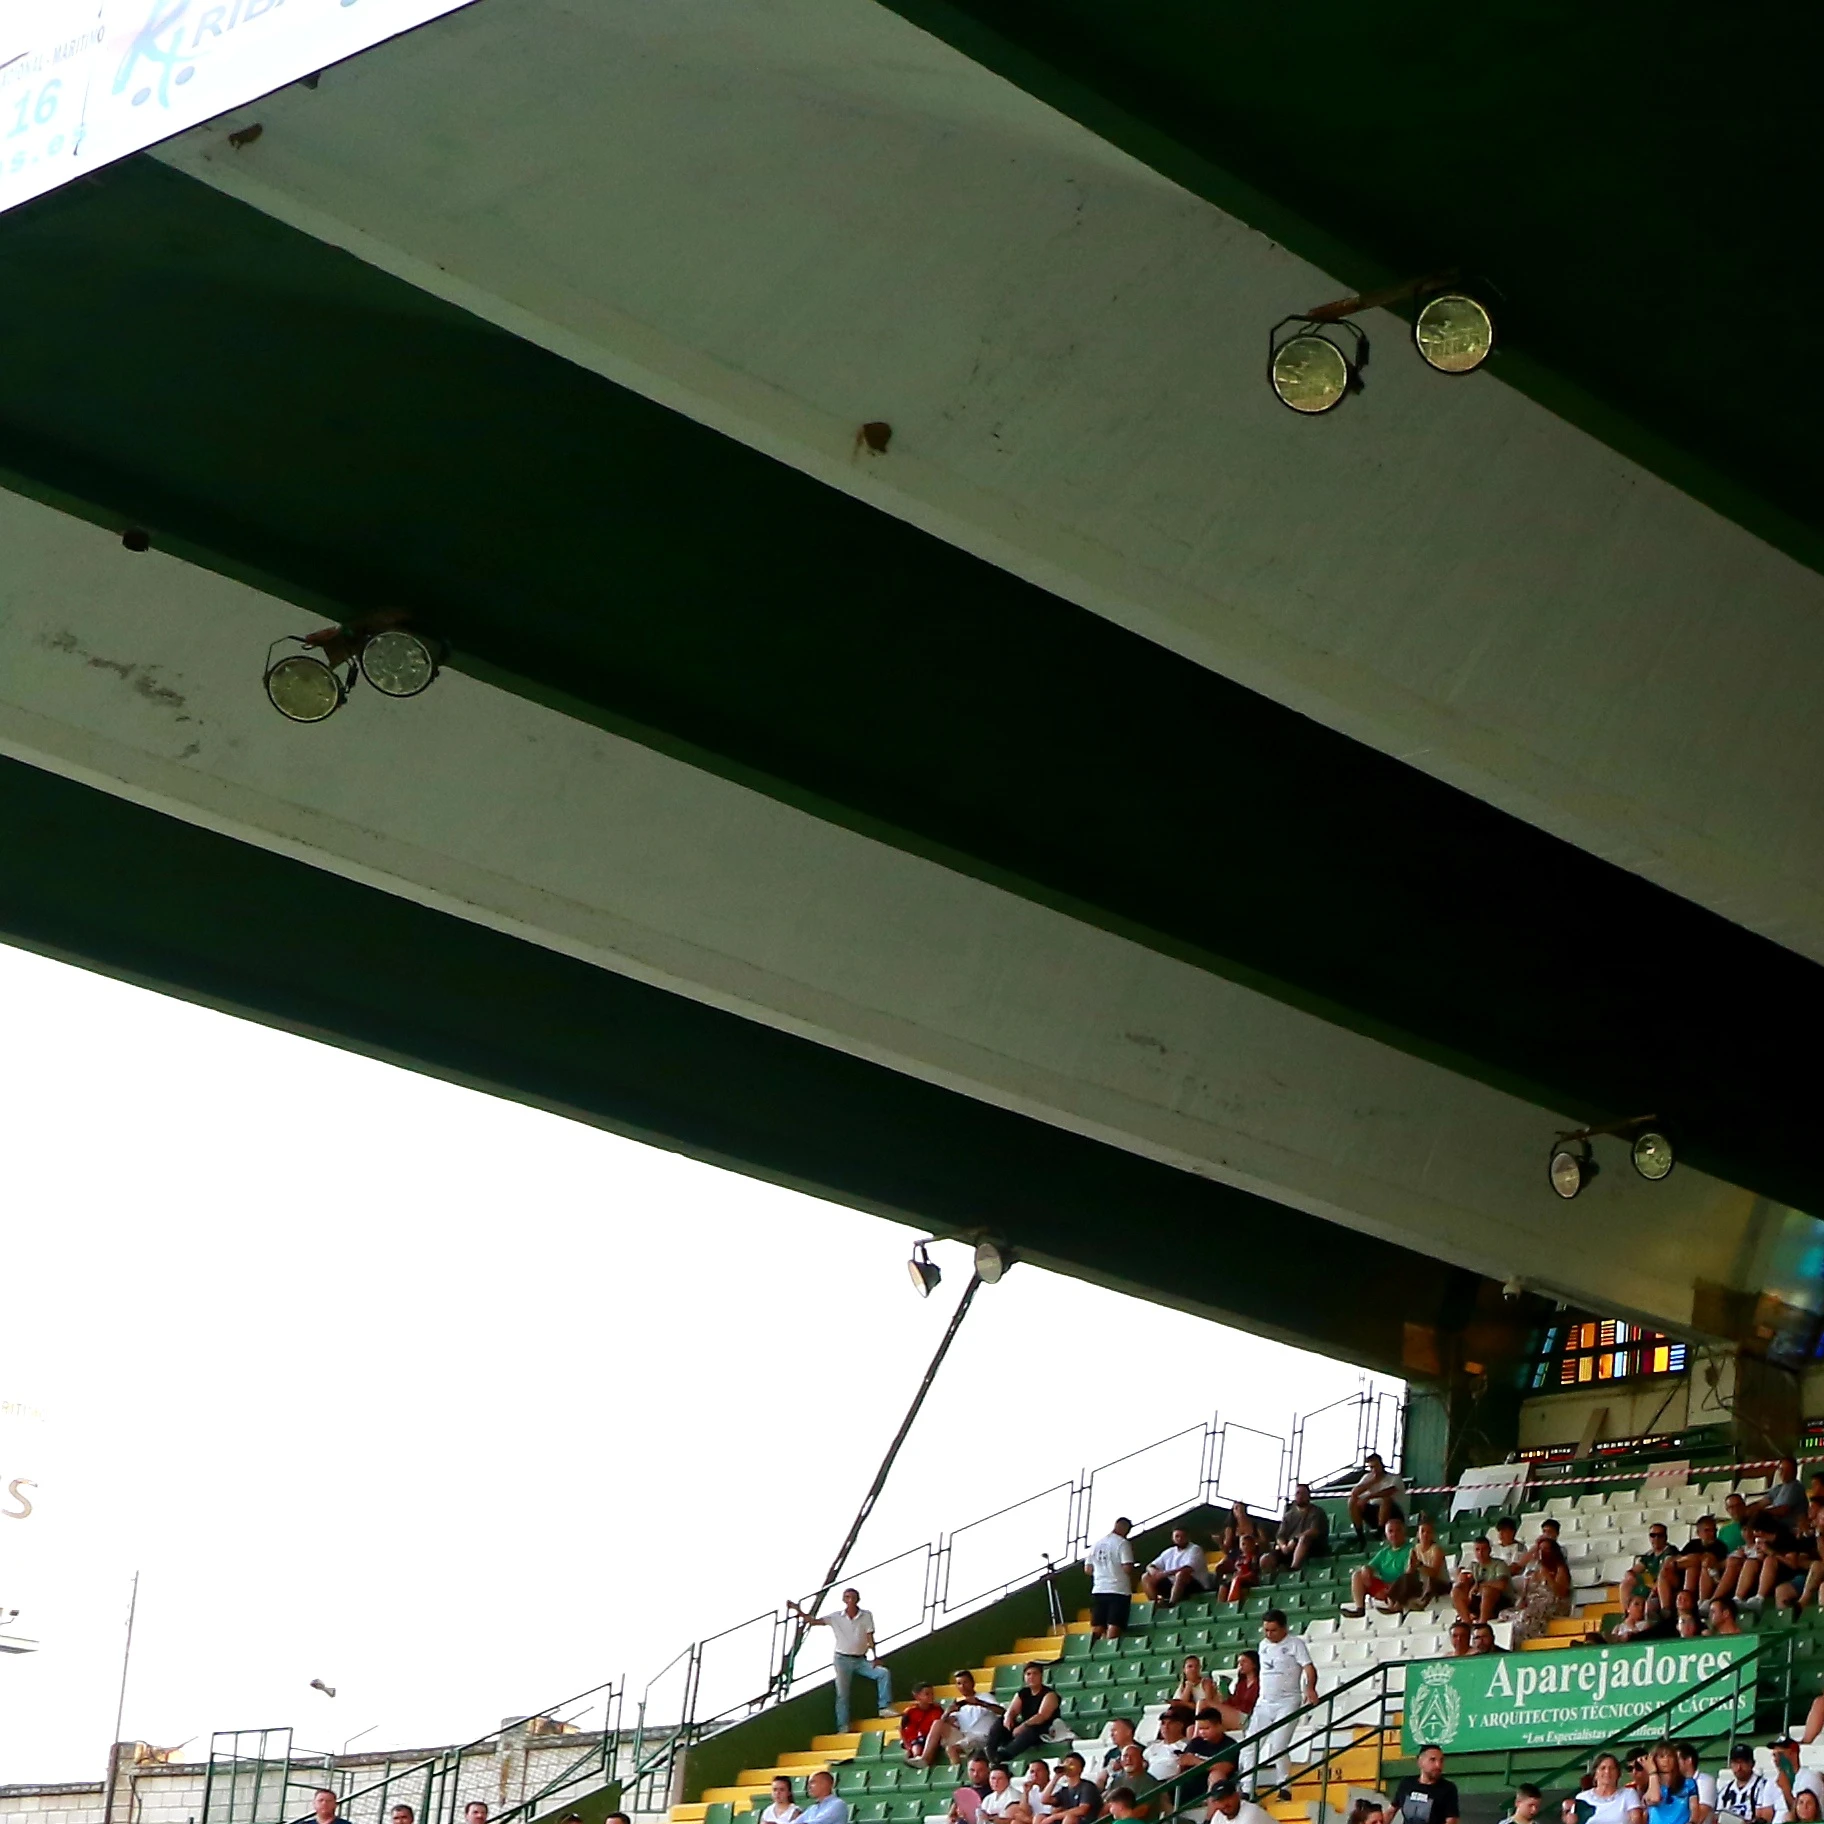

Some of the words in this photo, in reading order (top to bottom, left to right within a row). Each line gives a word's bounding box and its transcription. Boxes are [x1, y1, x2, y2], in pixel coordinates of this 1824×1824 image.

[1485, 1646, 1734, 1707] Aparejadores
[1468, 1714, 1477, 1728] Y
[1480, 1706, 1578, 1728] ARQUITECTOS
[1580, 1701, 1652, 1720] TÉCNICOS
